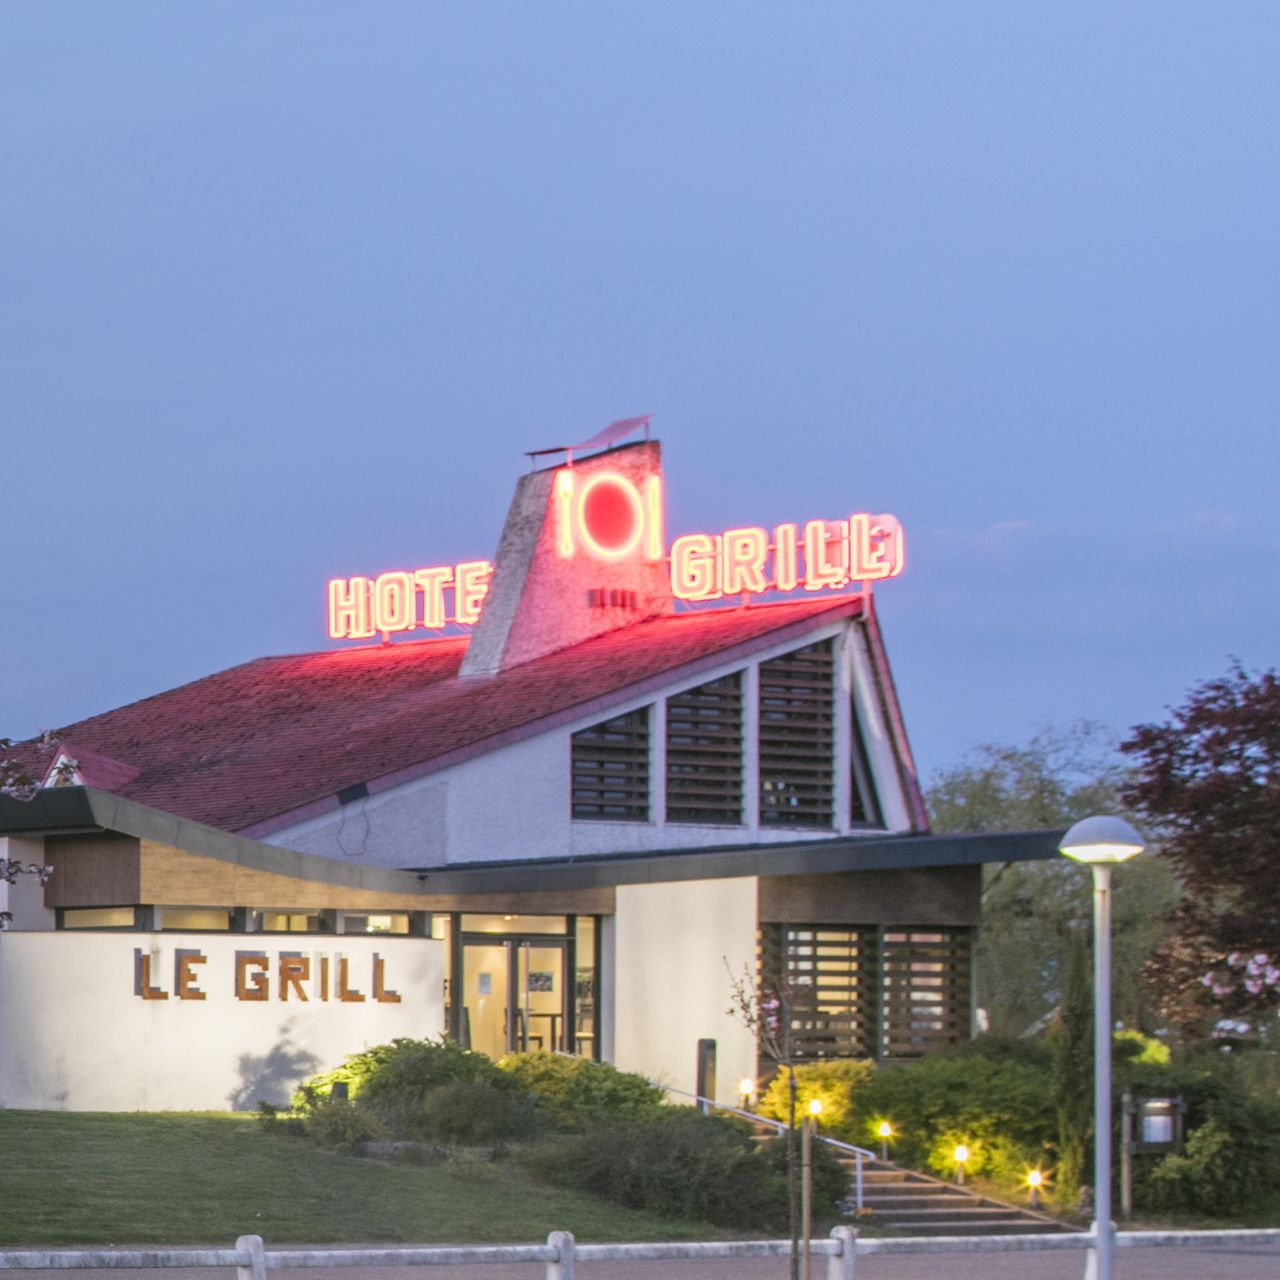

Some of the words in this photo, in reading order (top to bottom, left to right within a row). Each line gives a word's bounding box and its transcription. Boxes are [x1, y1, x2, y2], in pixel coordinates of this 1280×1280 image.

[328, 560, 493, 639] HOTE
[670, 513, 900, 601] GRILL
[142, 954, 208, 1001] LE
[238, 956, 402, 1003] GRILL
